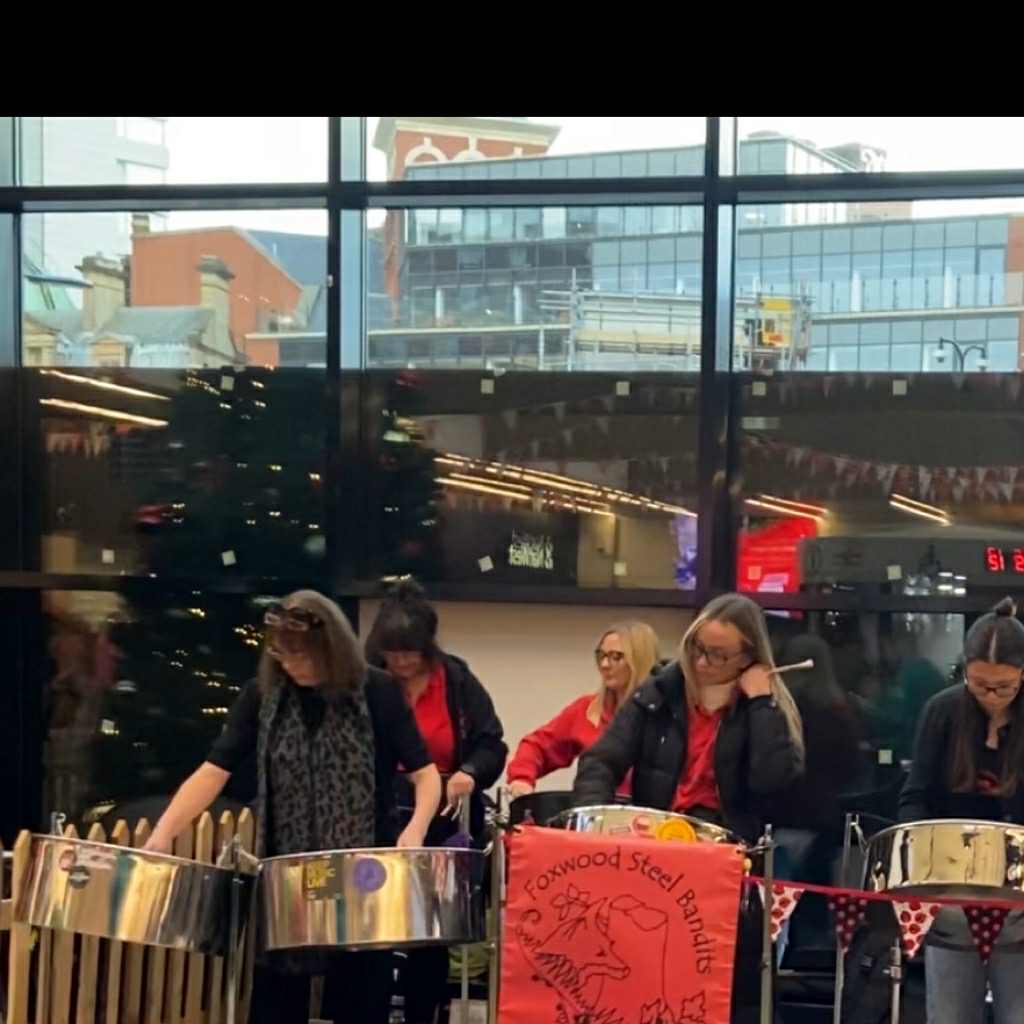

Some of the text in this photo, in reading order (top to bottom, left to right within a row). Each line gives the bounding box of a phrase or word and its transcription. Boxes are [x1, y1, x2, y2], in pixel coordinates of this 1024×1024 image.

[523, 845, 717, 976] Foxwood Steel Bandits
